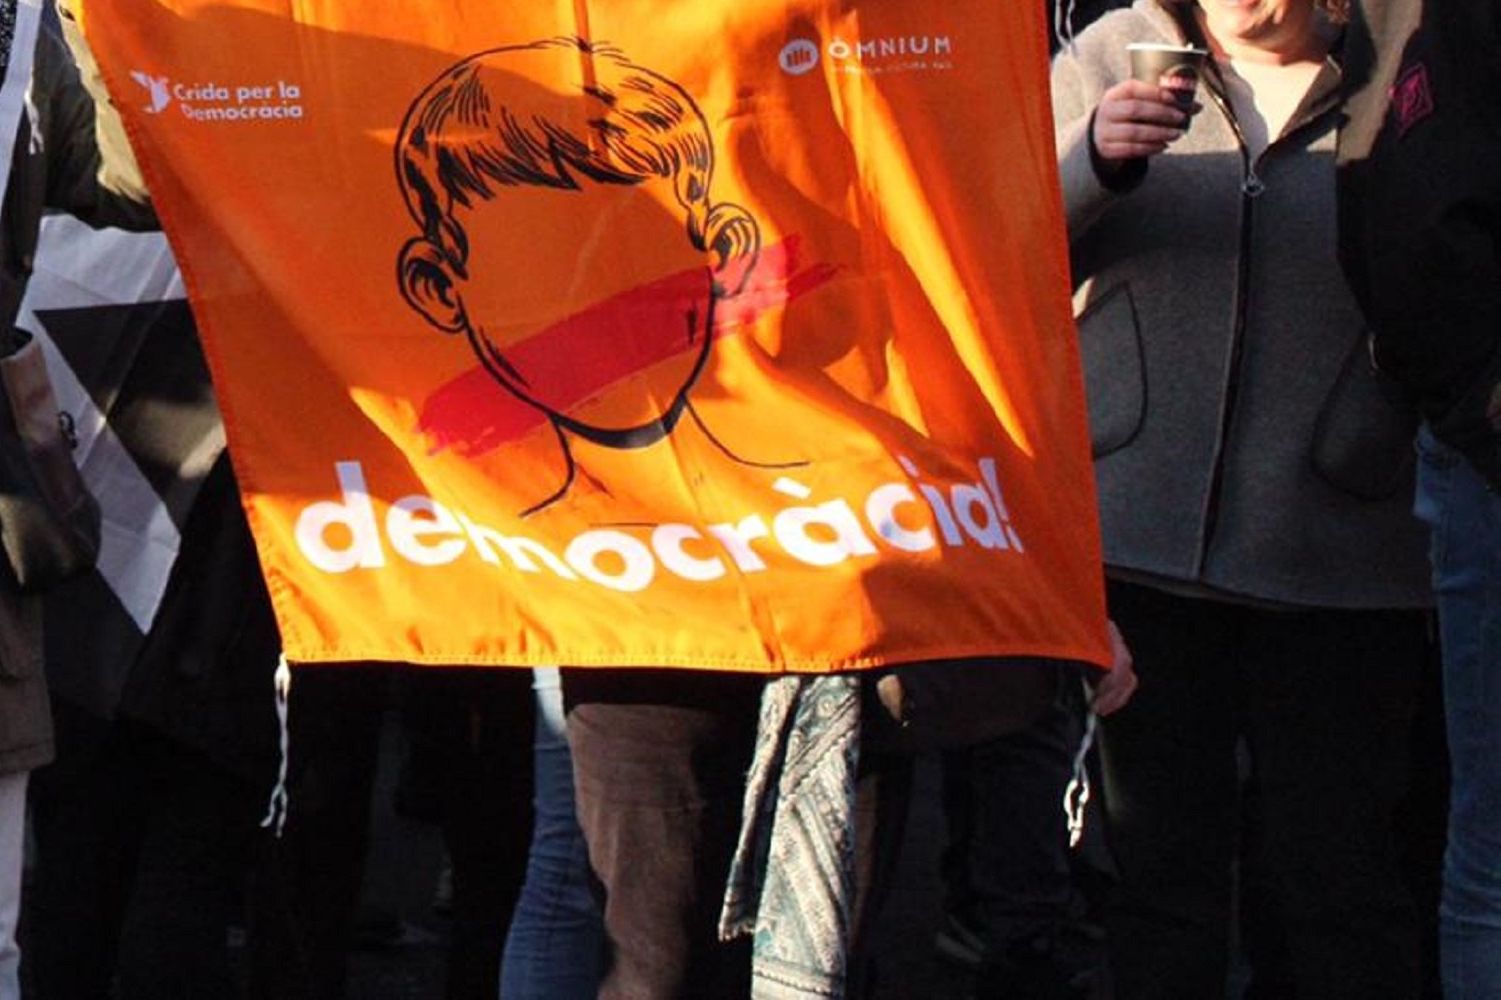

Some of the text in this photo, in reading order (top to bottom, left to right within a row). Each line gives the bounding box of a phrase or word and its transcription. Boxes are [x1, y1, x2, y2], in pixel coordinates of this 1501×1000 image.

[173, 80, 300, 105] Crida per la
[294, 457, 1025, 592] democràcia!
